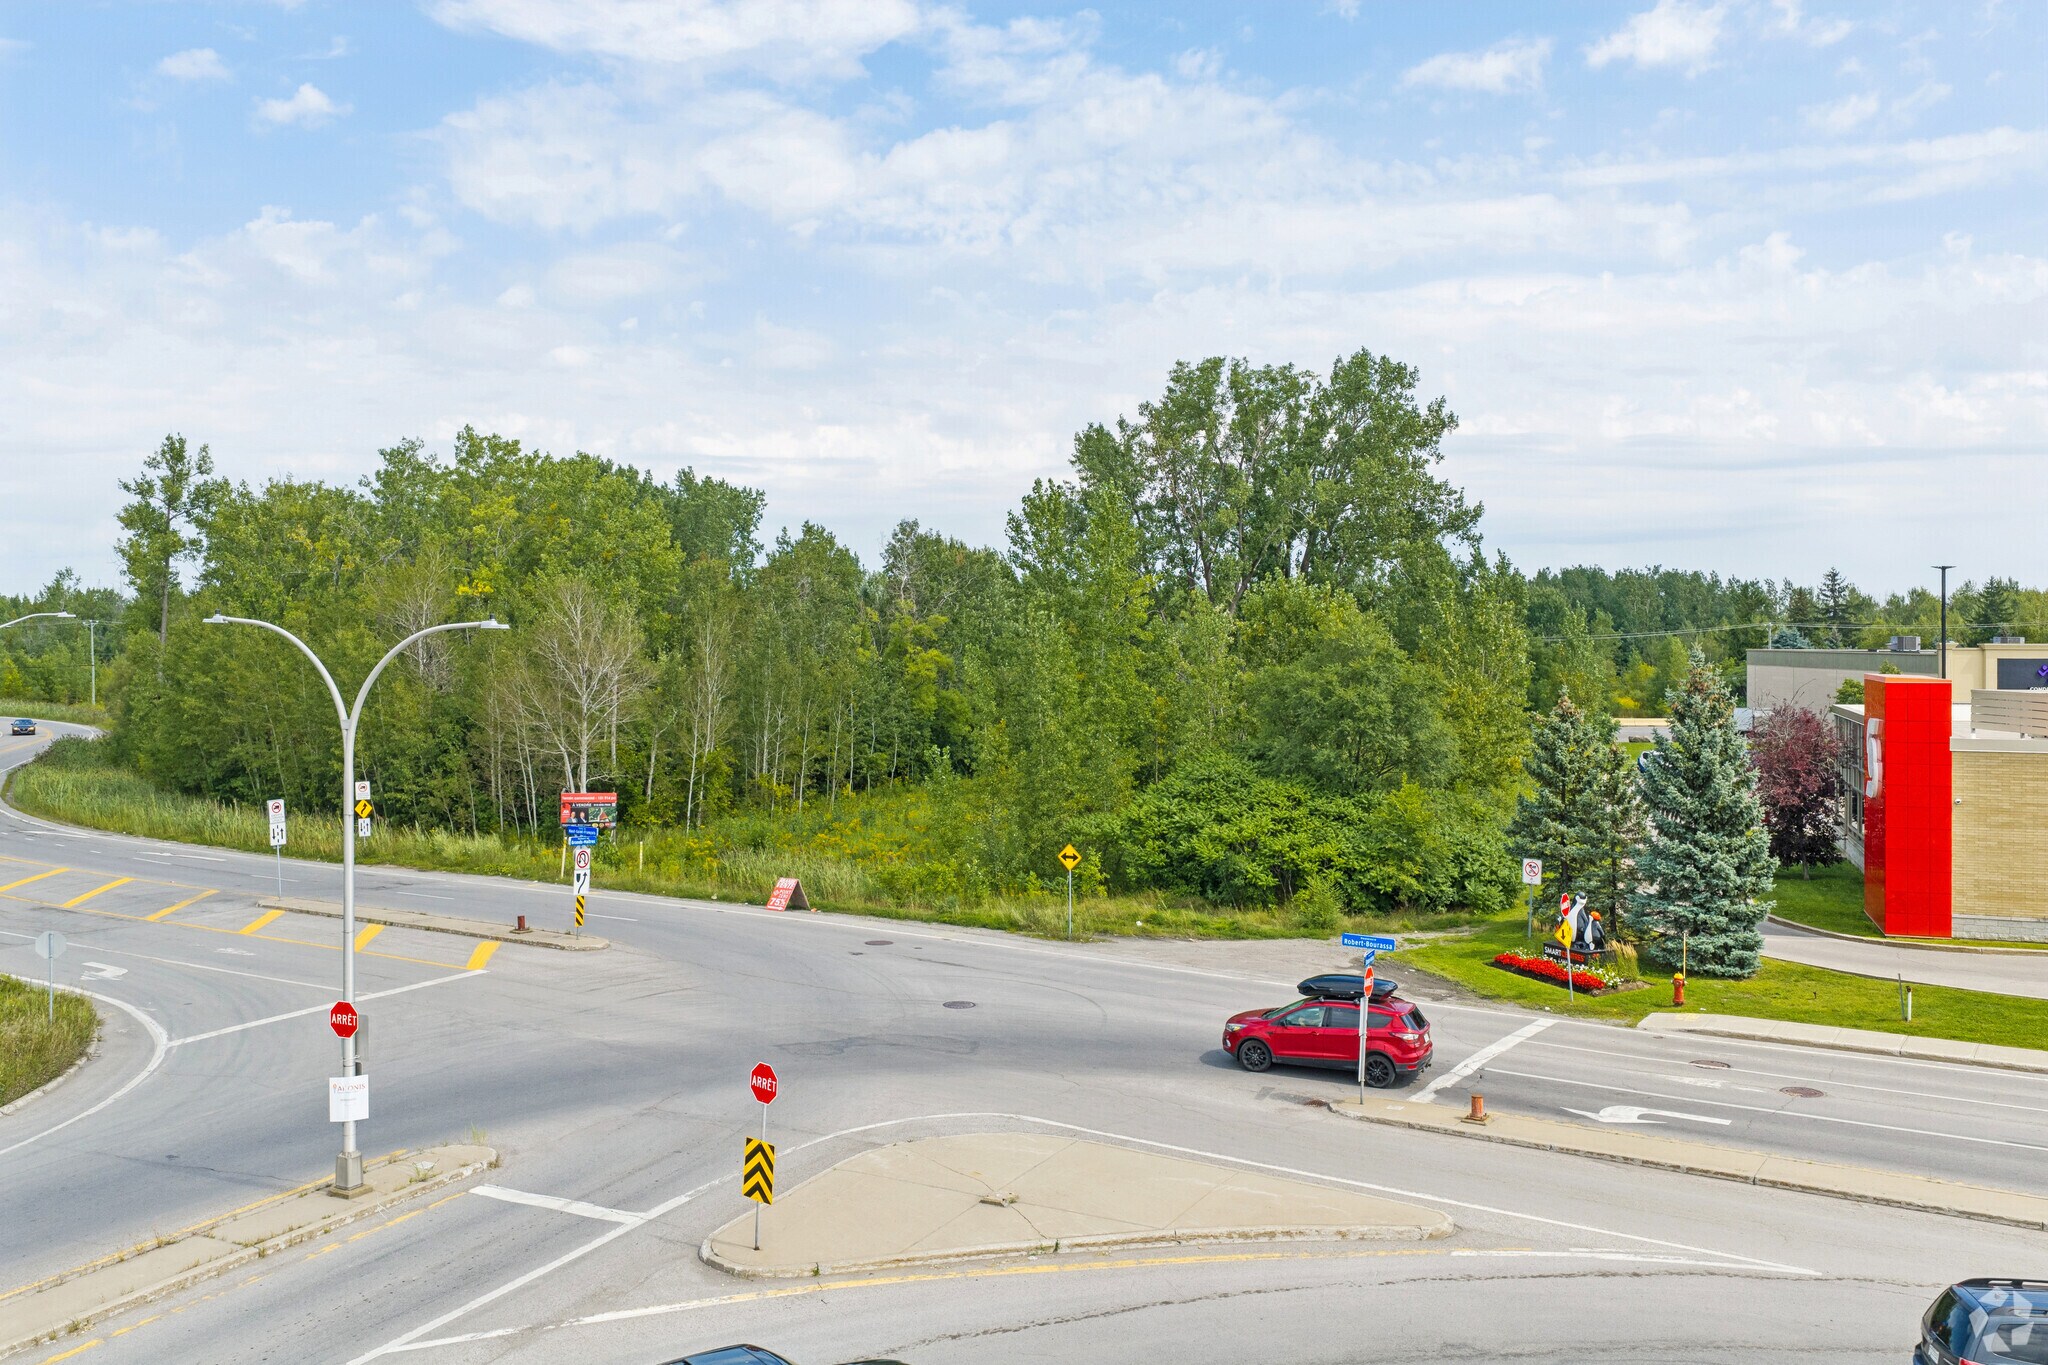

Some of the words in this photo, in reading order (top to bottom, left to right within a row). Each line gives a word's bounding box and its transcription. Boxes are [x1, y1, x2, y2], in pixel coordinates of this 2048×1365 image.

[1343, 939, 1393, 950] Robert-Bourassa
[1544, 946, 1586, 963] SMARTCNTRES
[331, 1013, 357, 1026] ARRÊT
[751, 1074, 777, 1093] ARRÊT
